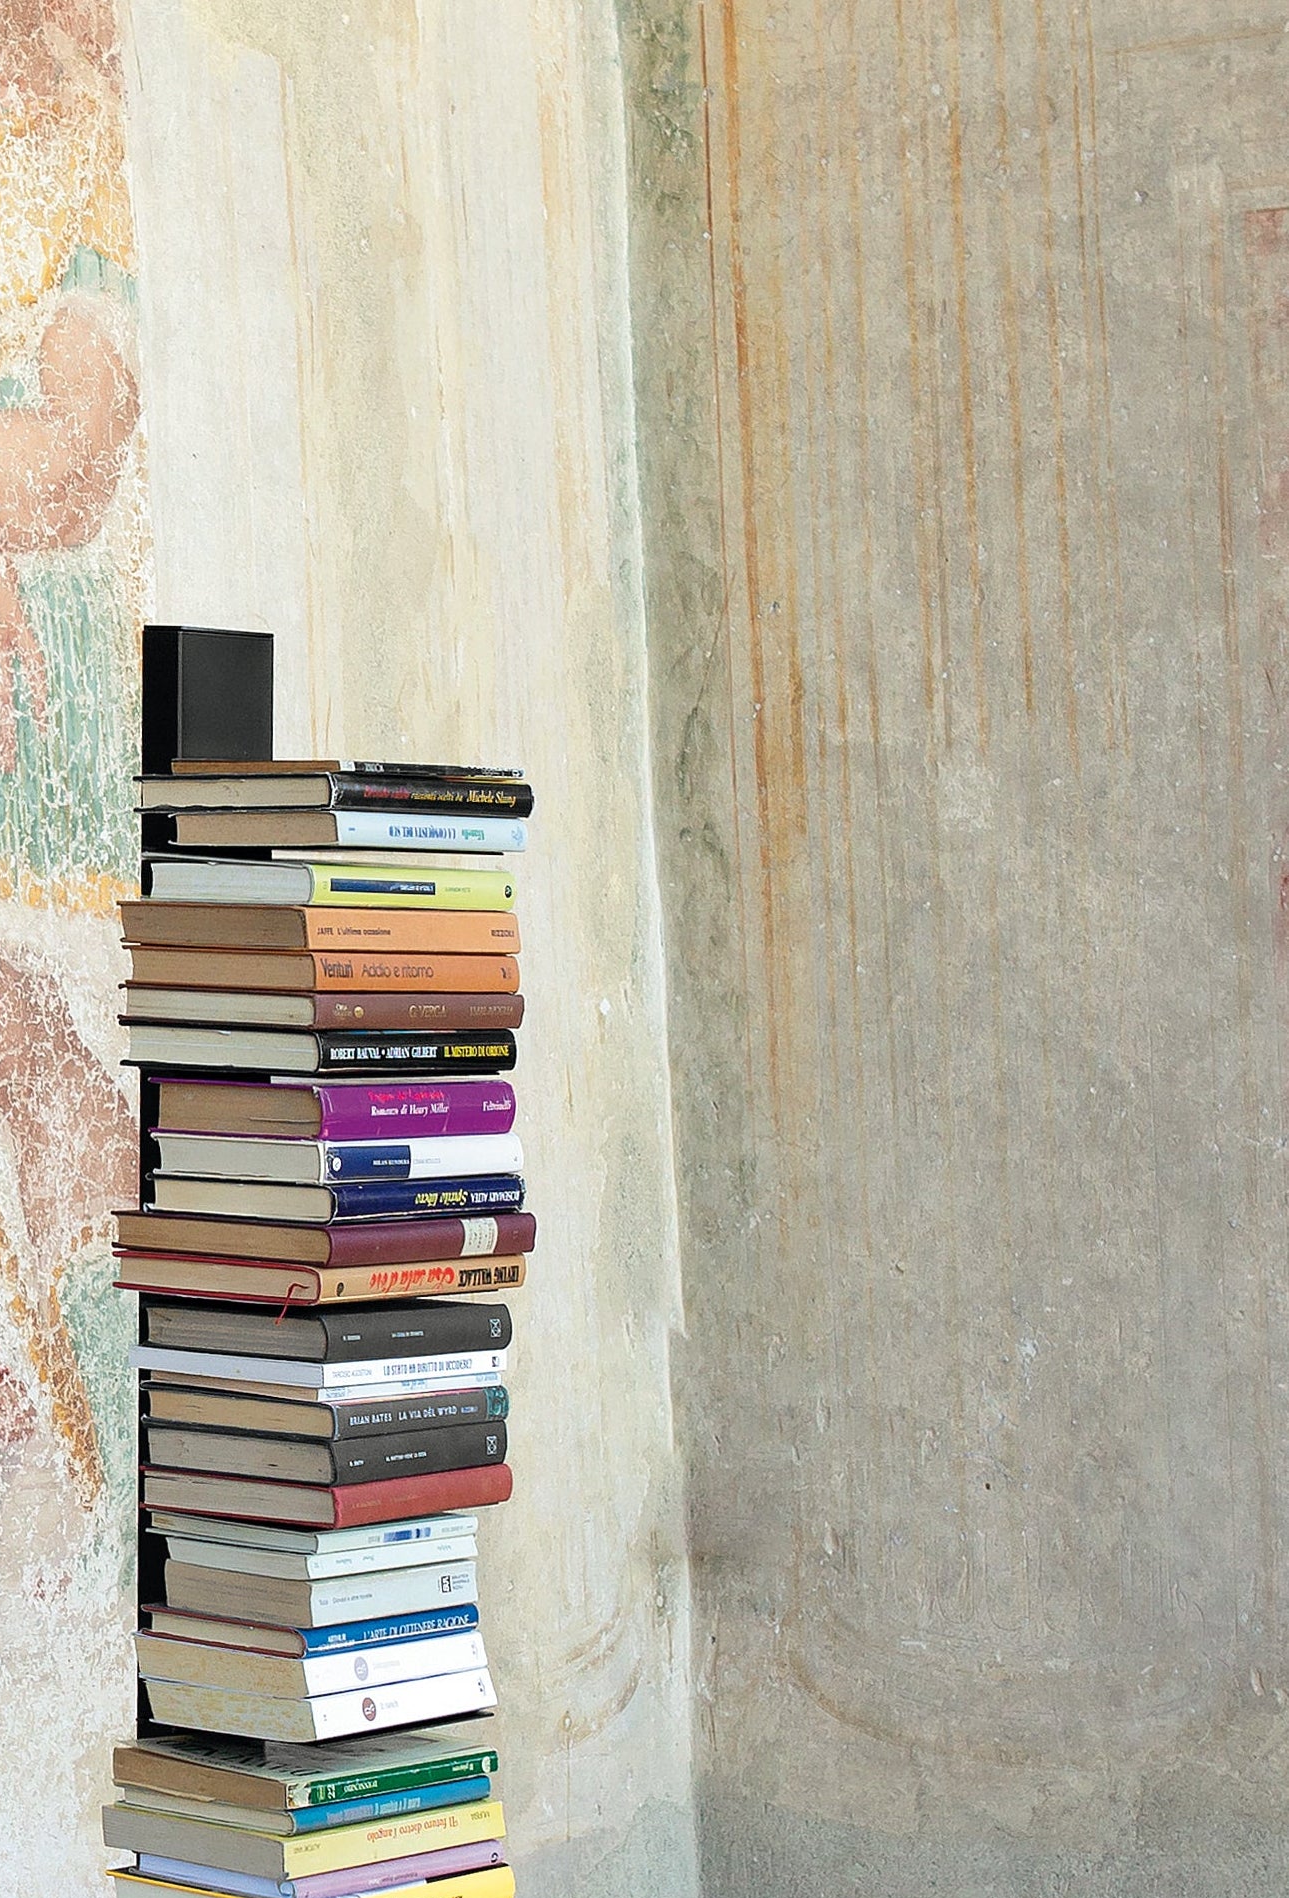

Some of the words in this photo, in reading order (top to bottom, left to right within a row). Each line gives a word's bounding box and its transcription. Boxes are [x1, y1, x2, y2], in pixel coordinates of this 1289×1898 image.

[466, 789, 494, 805] Michele
[320, 958, 353, 978] Venturi
[361, 962, 391, 977] Addio
[394, 966, 401, 977] e
[402, 964, 434, 977] ritorno
[330, 1048, 355, 1060] ROBERT
[385, 1047, 410, 1059] ADRIAN
[412, 1046, 438, 1058] GILBERT
[452, 1045, 478, 1057] MISTERO
[409, 1104, 429, 1118] Henry
[430, 1102, 449, 1114] Miller
[414, 1192, 439, 1207] libero
[440, 1188, 468, 1207] Spirito
[471, 1191, 489, 1204] ALTEA
[489, 1191, 520, 1204] ROSEMARY
[458, 1266, 492, 1287] WALLACE
[391, 1364, 408, 1376] STATO
[417, 1361, 438, 1374] DIRITTO
[349, 1415, 370, 1426] BRIAN
[371, 1413, 392, 1424] BATES
[398, 1411, 408, 1421] LA
[409, 1409, 422, 1419] VIA
[437, 1405, 458, 1416] WYRD
[363, 1627, 387, 1640] L'ARTE
[399, 1620, 436, 1635] OTTENERE
[437, 1614, 470, 1629] RAGIONE
[399, 1822, 422, 1836] dietro
[424, 1817, 447, 1832] futuro
[448, 1815, 459, 1828] Il
[366, 1827, 397, 1843] l'angolo
